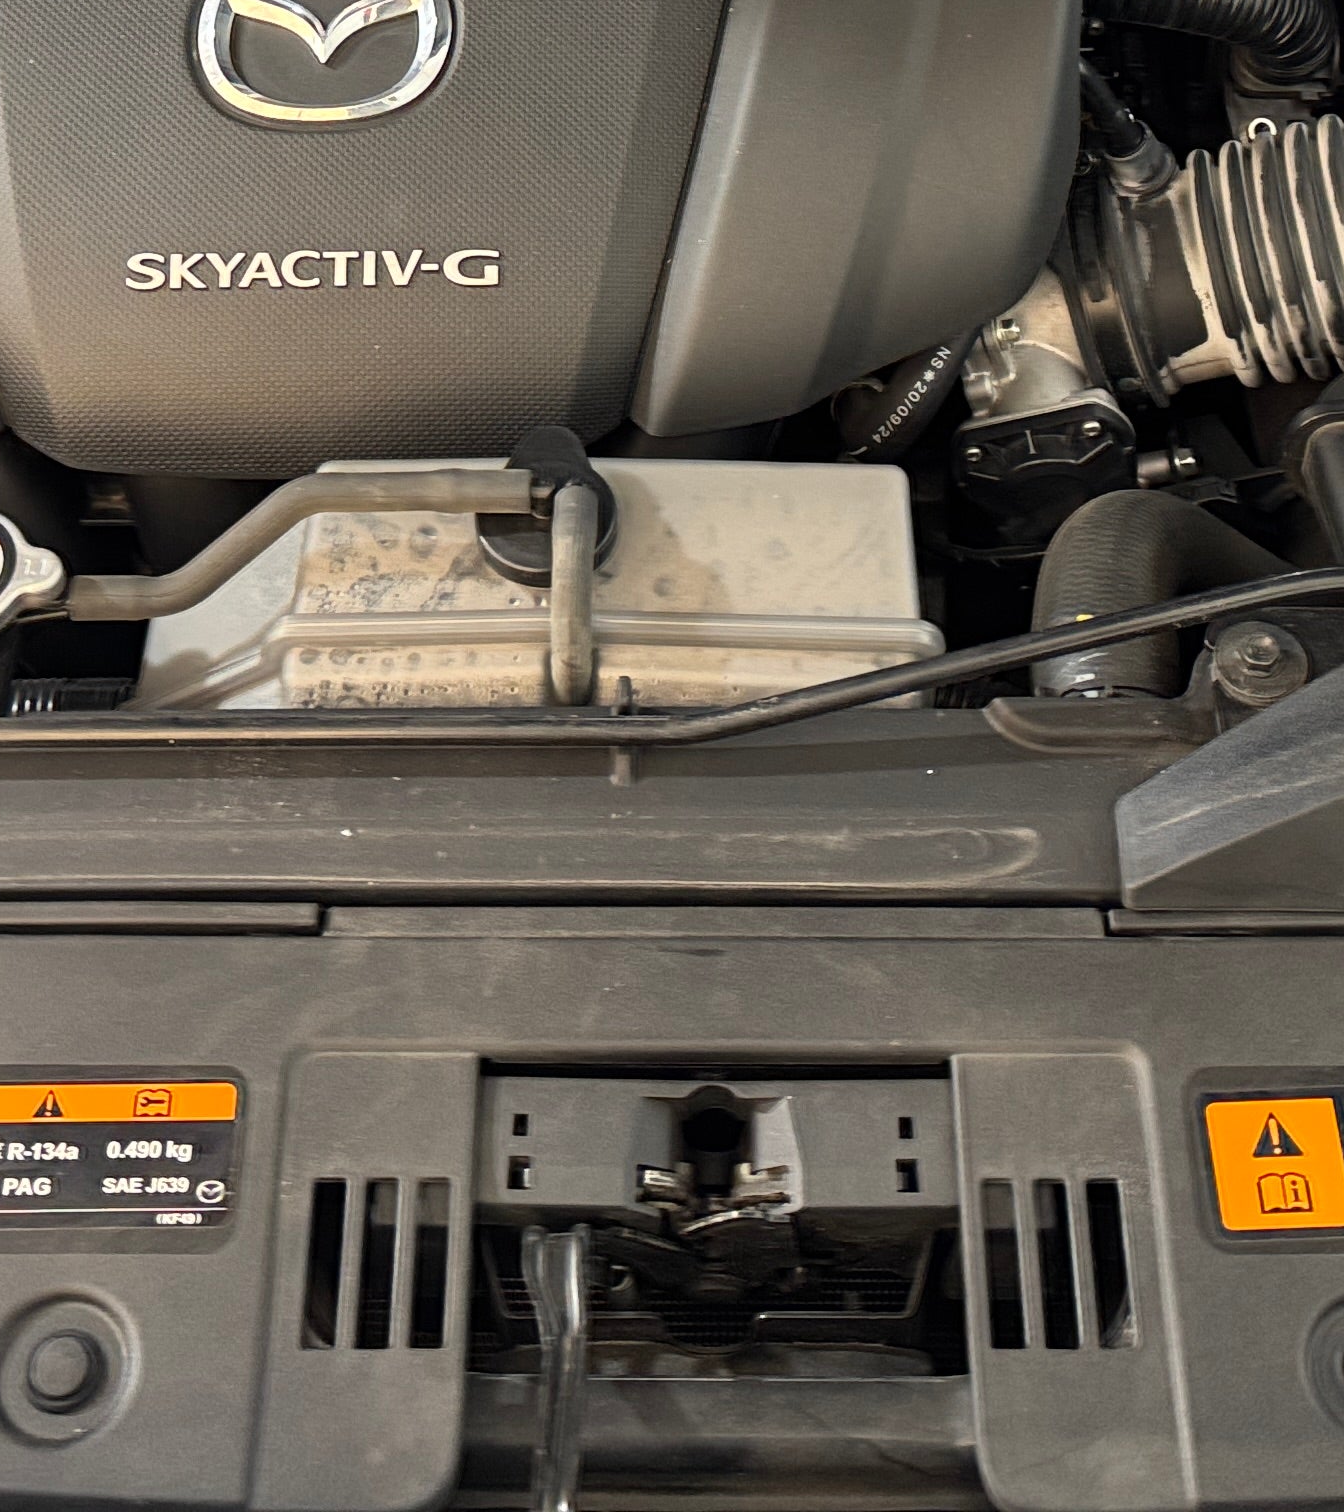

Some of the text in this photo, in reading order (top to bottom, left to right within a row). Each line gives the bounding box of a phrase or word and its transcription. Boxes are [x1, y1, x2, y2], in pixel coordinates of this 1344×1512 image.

[125, 249, 500, 290] SKYACTIV-G
[6, 1140, 194, 1163] R-134a 0.490 kg
[1, 1176, 190, 1197] PAG SAE J639
